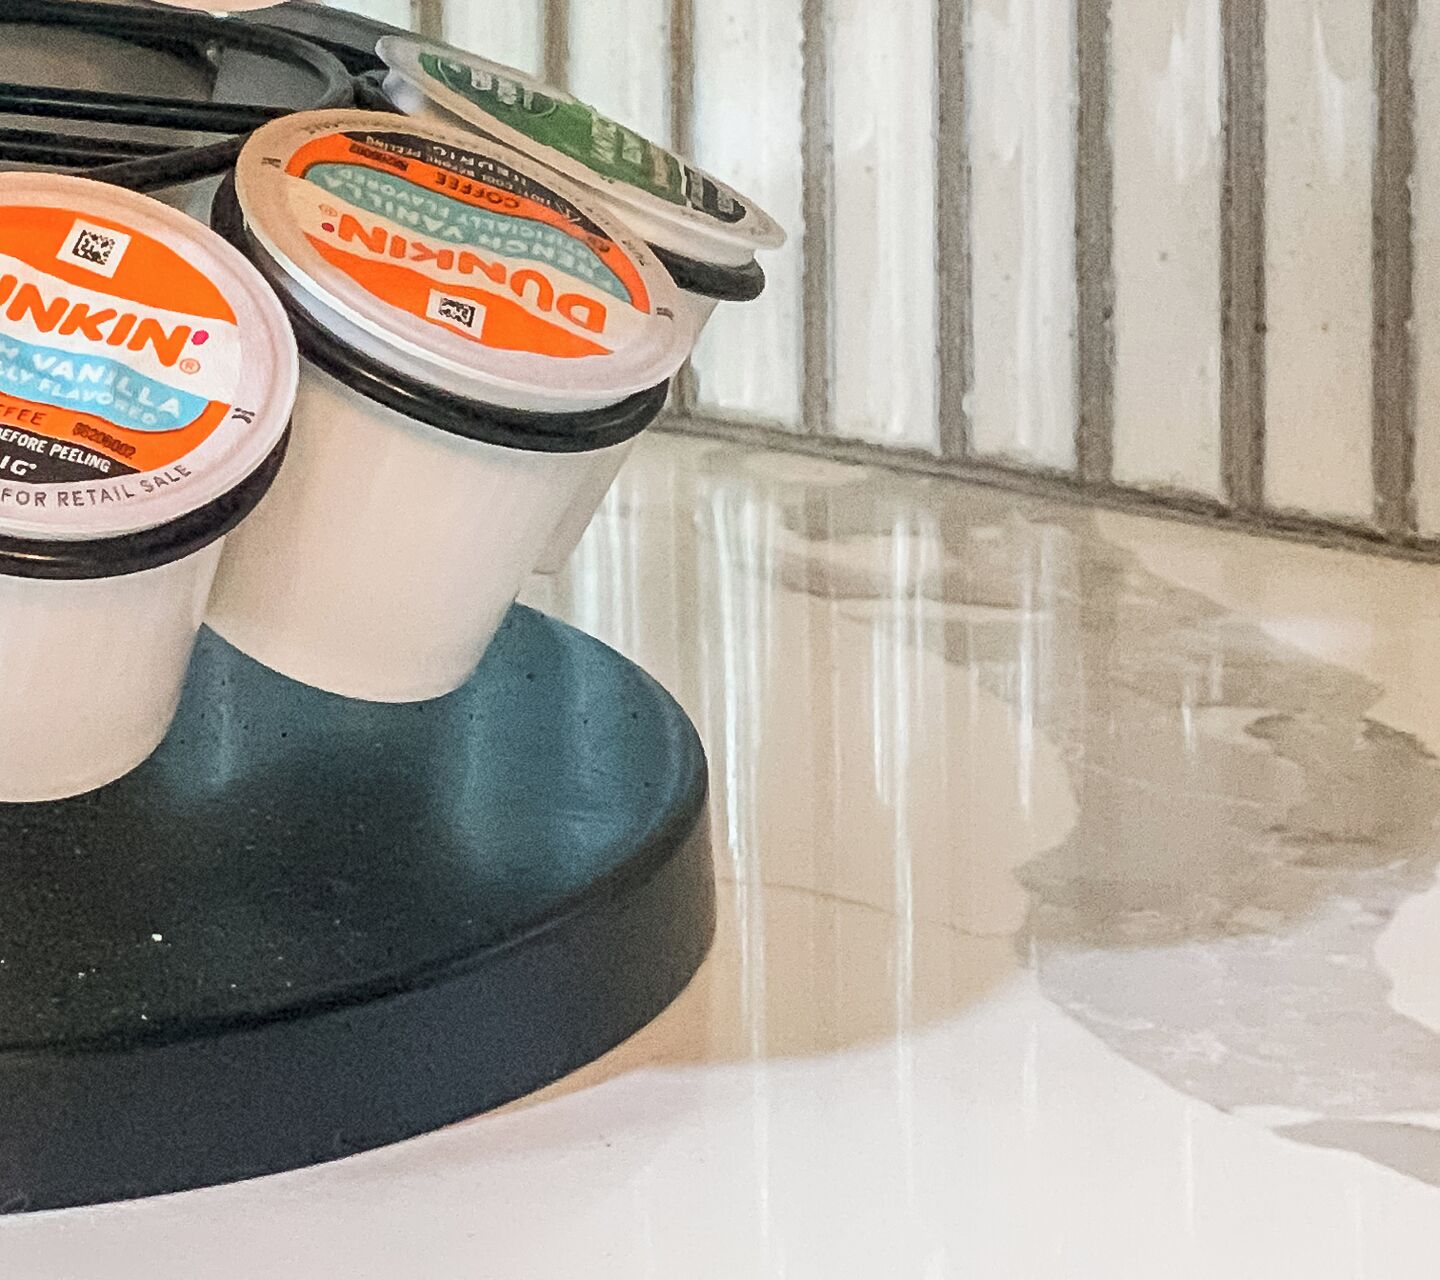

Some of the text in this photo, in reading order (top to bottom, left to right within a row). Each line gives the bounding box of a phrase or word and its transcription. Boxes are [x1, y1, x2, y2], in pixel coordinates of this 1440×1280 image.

[435, 171, 520, 209] COFFEE
[31, 351, 182, 419] VANILLA
[49, 443, 112, 475] PEELING
[0, 486, 48, 507] FOR
[55, 483, 136, 508] RETAIL
[142, 463, 193, 494] SALE
